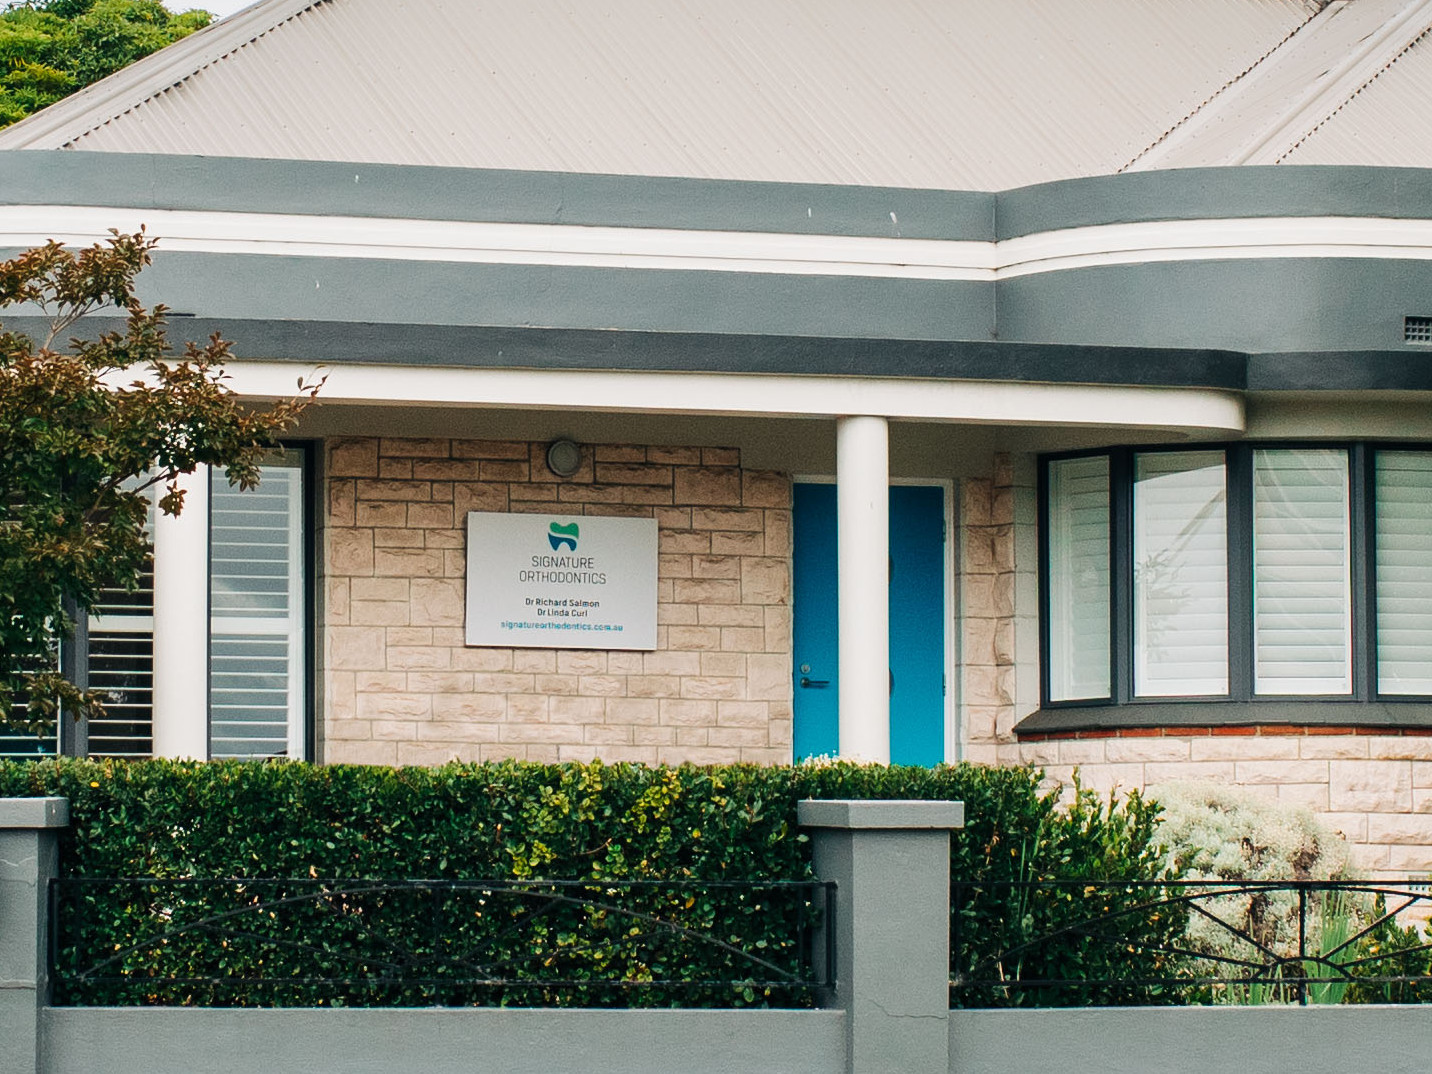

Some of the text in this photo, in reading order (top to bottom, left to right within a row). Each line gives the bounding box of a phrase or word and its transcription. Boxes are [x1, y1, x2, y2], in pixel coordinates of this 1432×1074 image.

[531, 555, 594, 569] SIGNATURE
[519, 570, 607, 585] ORTHODONTICS
[525, 598, 600, 608] Dr Richard Salmon
[537, 608, 546, 616] Dr
[547, 608, 569, 617] Linda
[500, 620, 623, 632] signatureorthodontics.com.au
